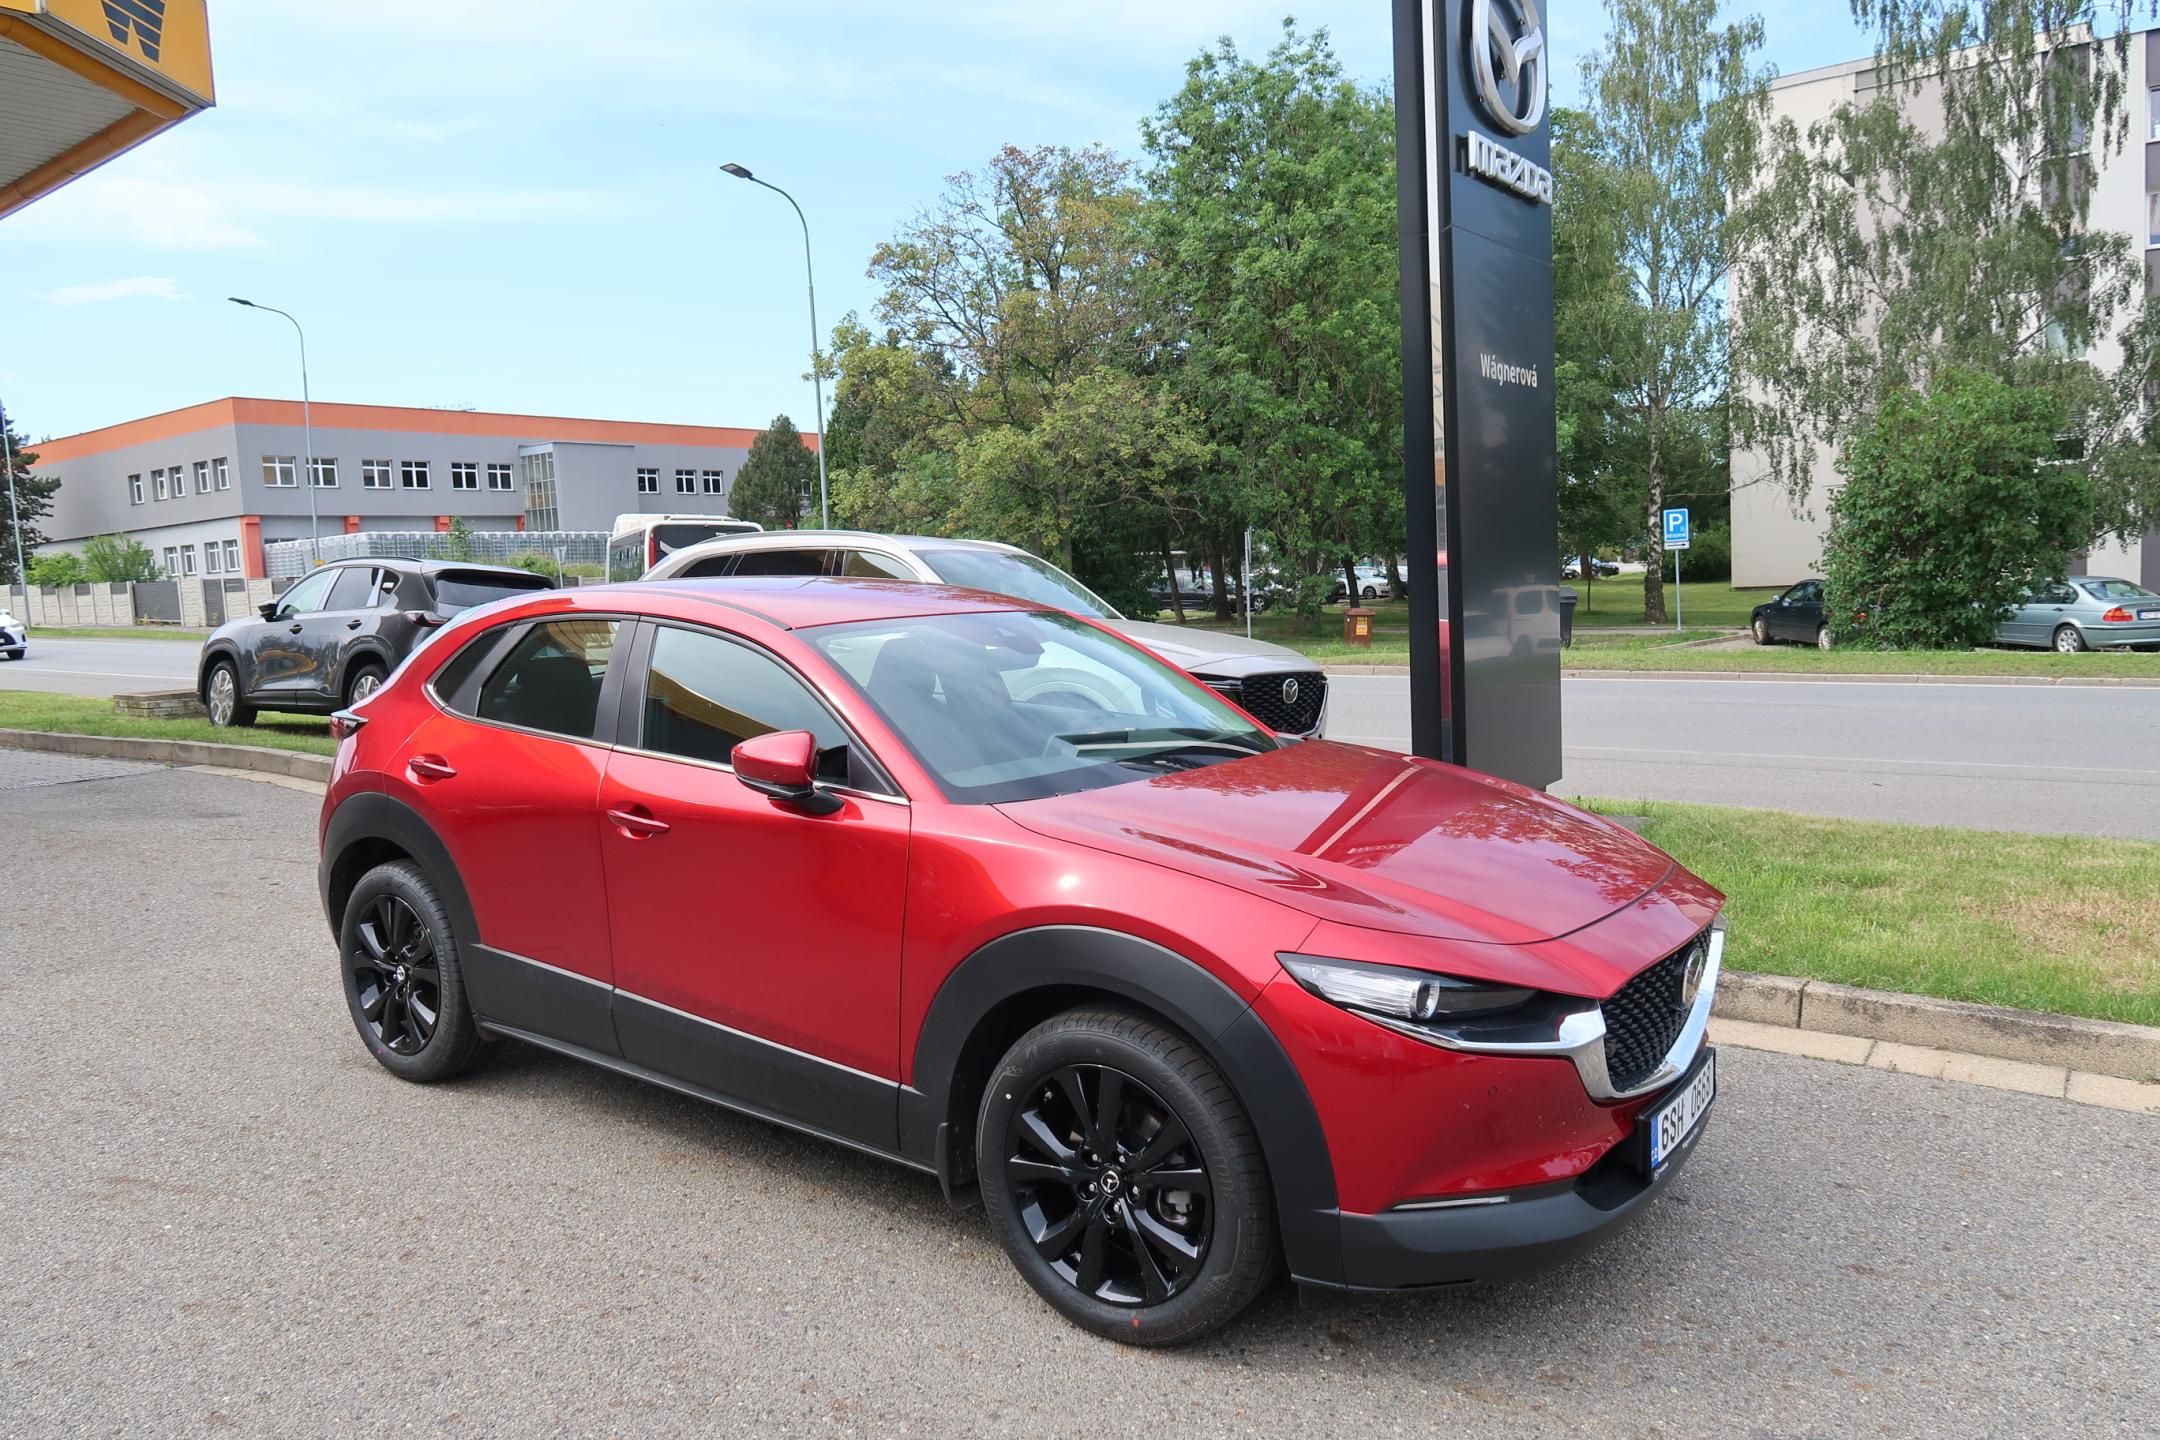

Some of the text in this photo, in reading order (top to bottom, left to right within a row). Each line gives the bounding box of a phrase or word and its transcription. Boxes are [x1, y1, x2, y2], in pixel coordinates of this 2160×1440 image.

[1480, 352, 1538, 388] Wágnerová
[1669, 513, 1683, 532] P
[1661, 1097, 1685, 1151] 6SH
